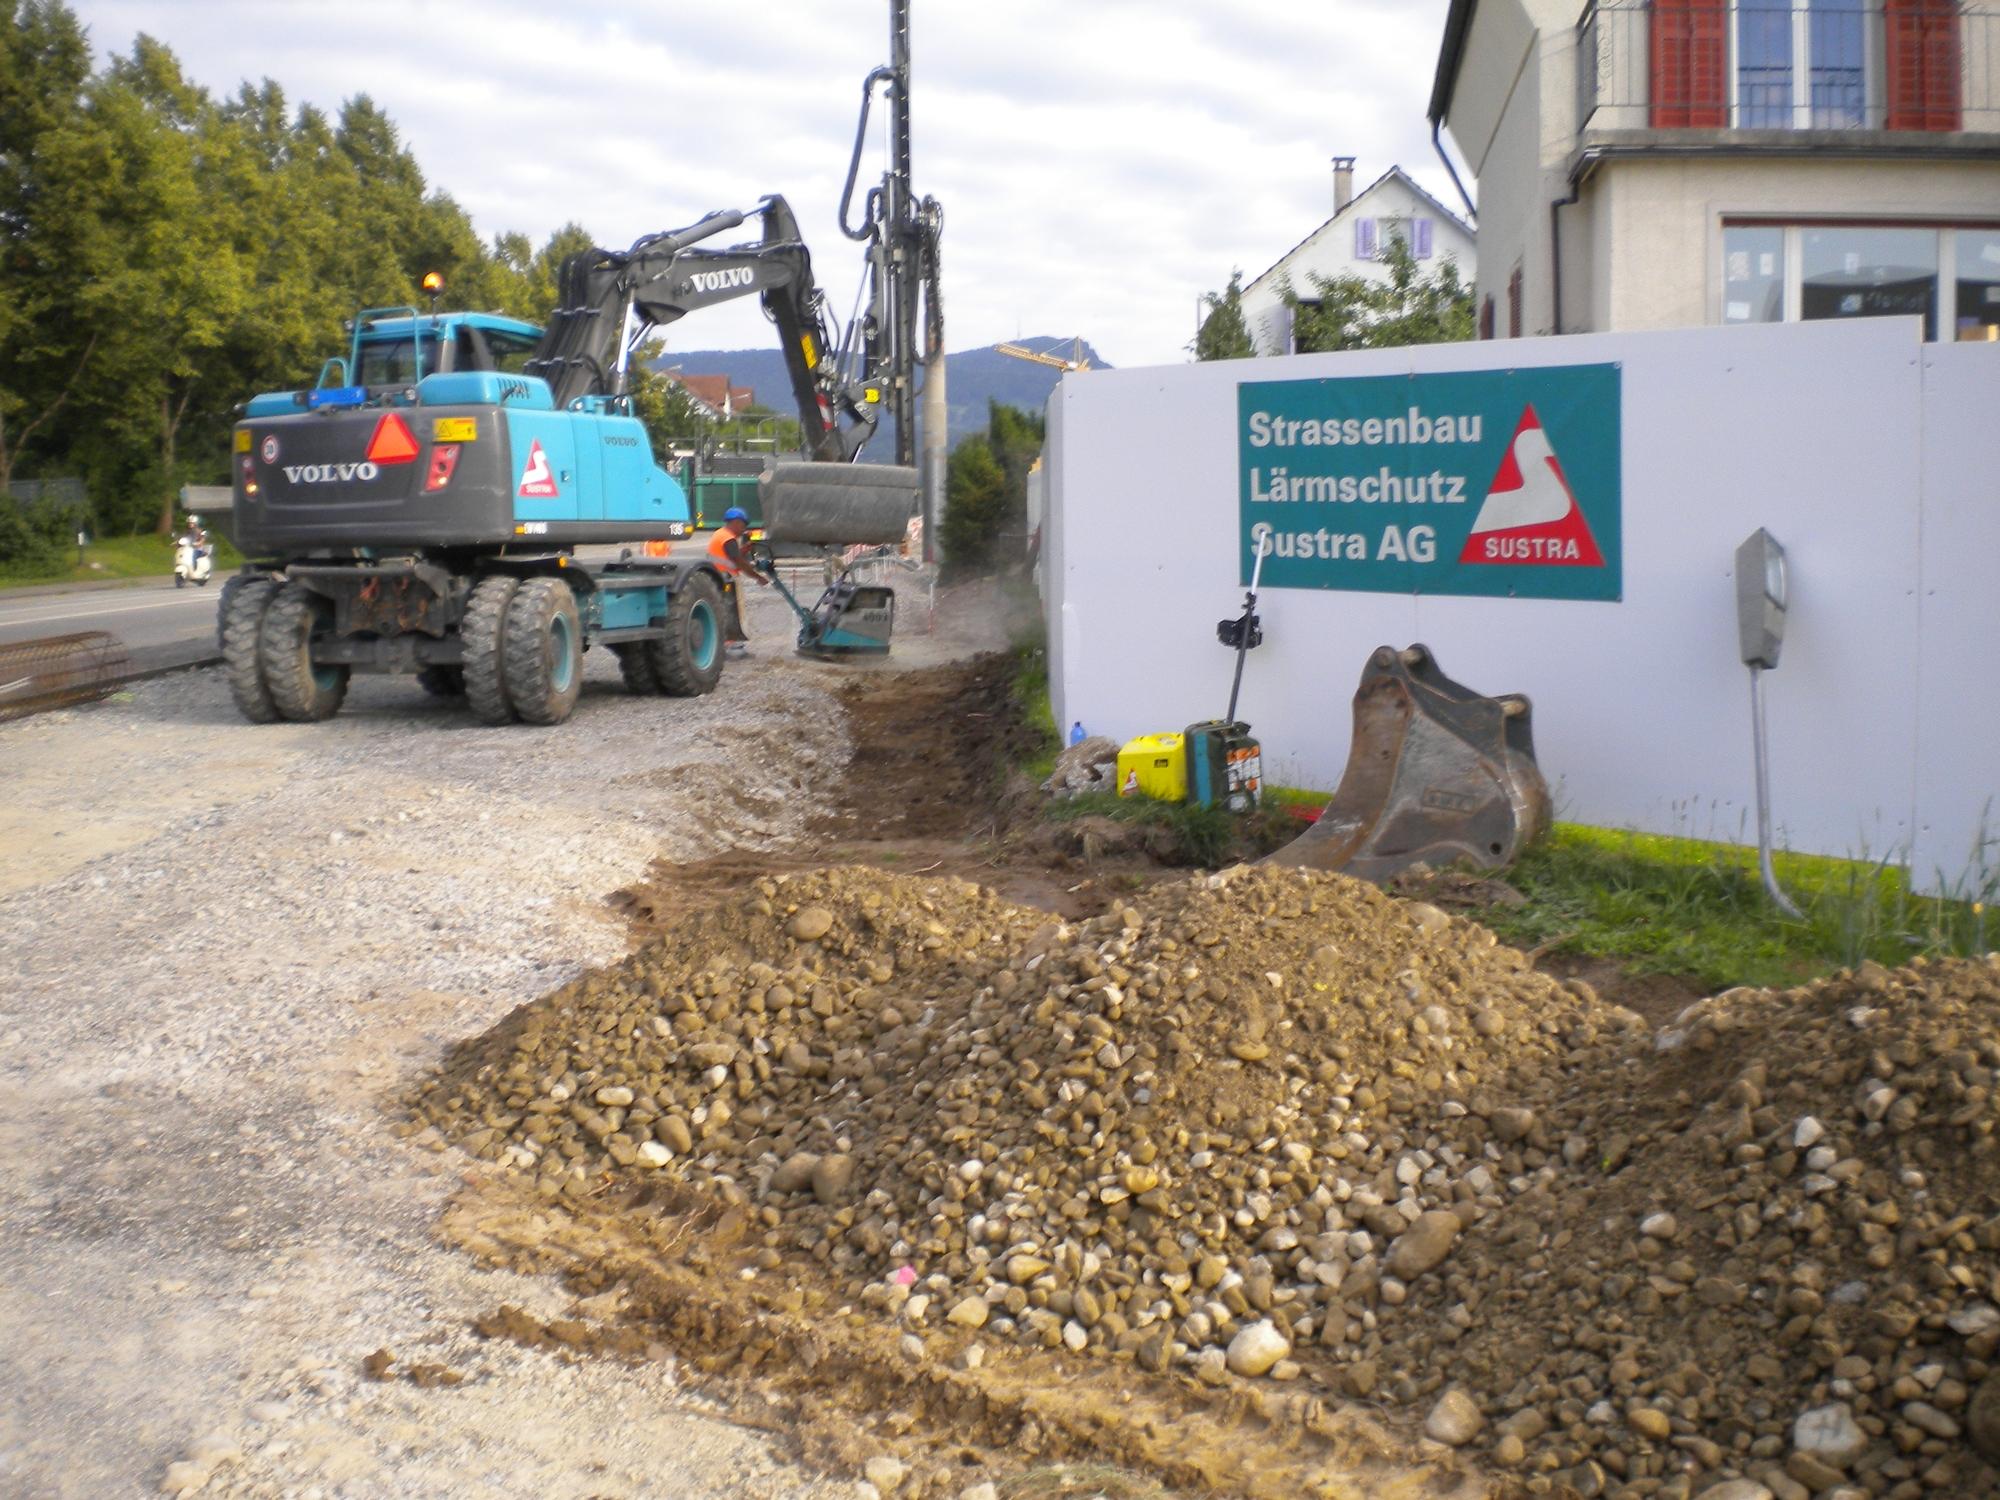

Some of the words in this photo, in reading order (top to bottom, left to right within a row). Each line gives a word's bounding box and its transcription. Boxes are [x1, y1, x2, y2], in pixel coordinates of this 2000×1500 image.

[690, 266, 754, 293] VOLVO
[1249, 407, 1481, 447] Strassenbau
[283, 462, 378, 484] VOLVO
[1251, 467, 1466, 504] Lärmschutz
[1251, 522, 1366, 560] Sustra
[1376, 525, 1436, 562] AG
[1485, 537, 1580, 560] SUSTRA
